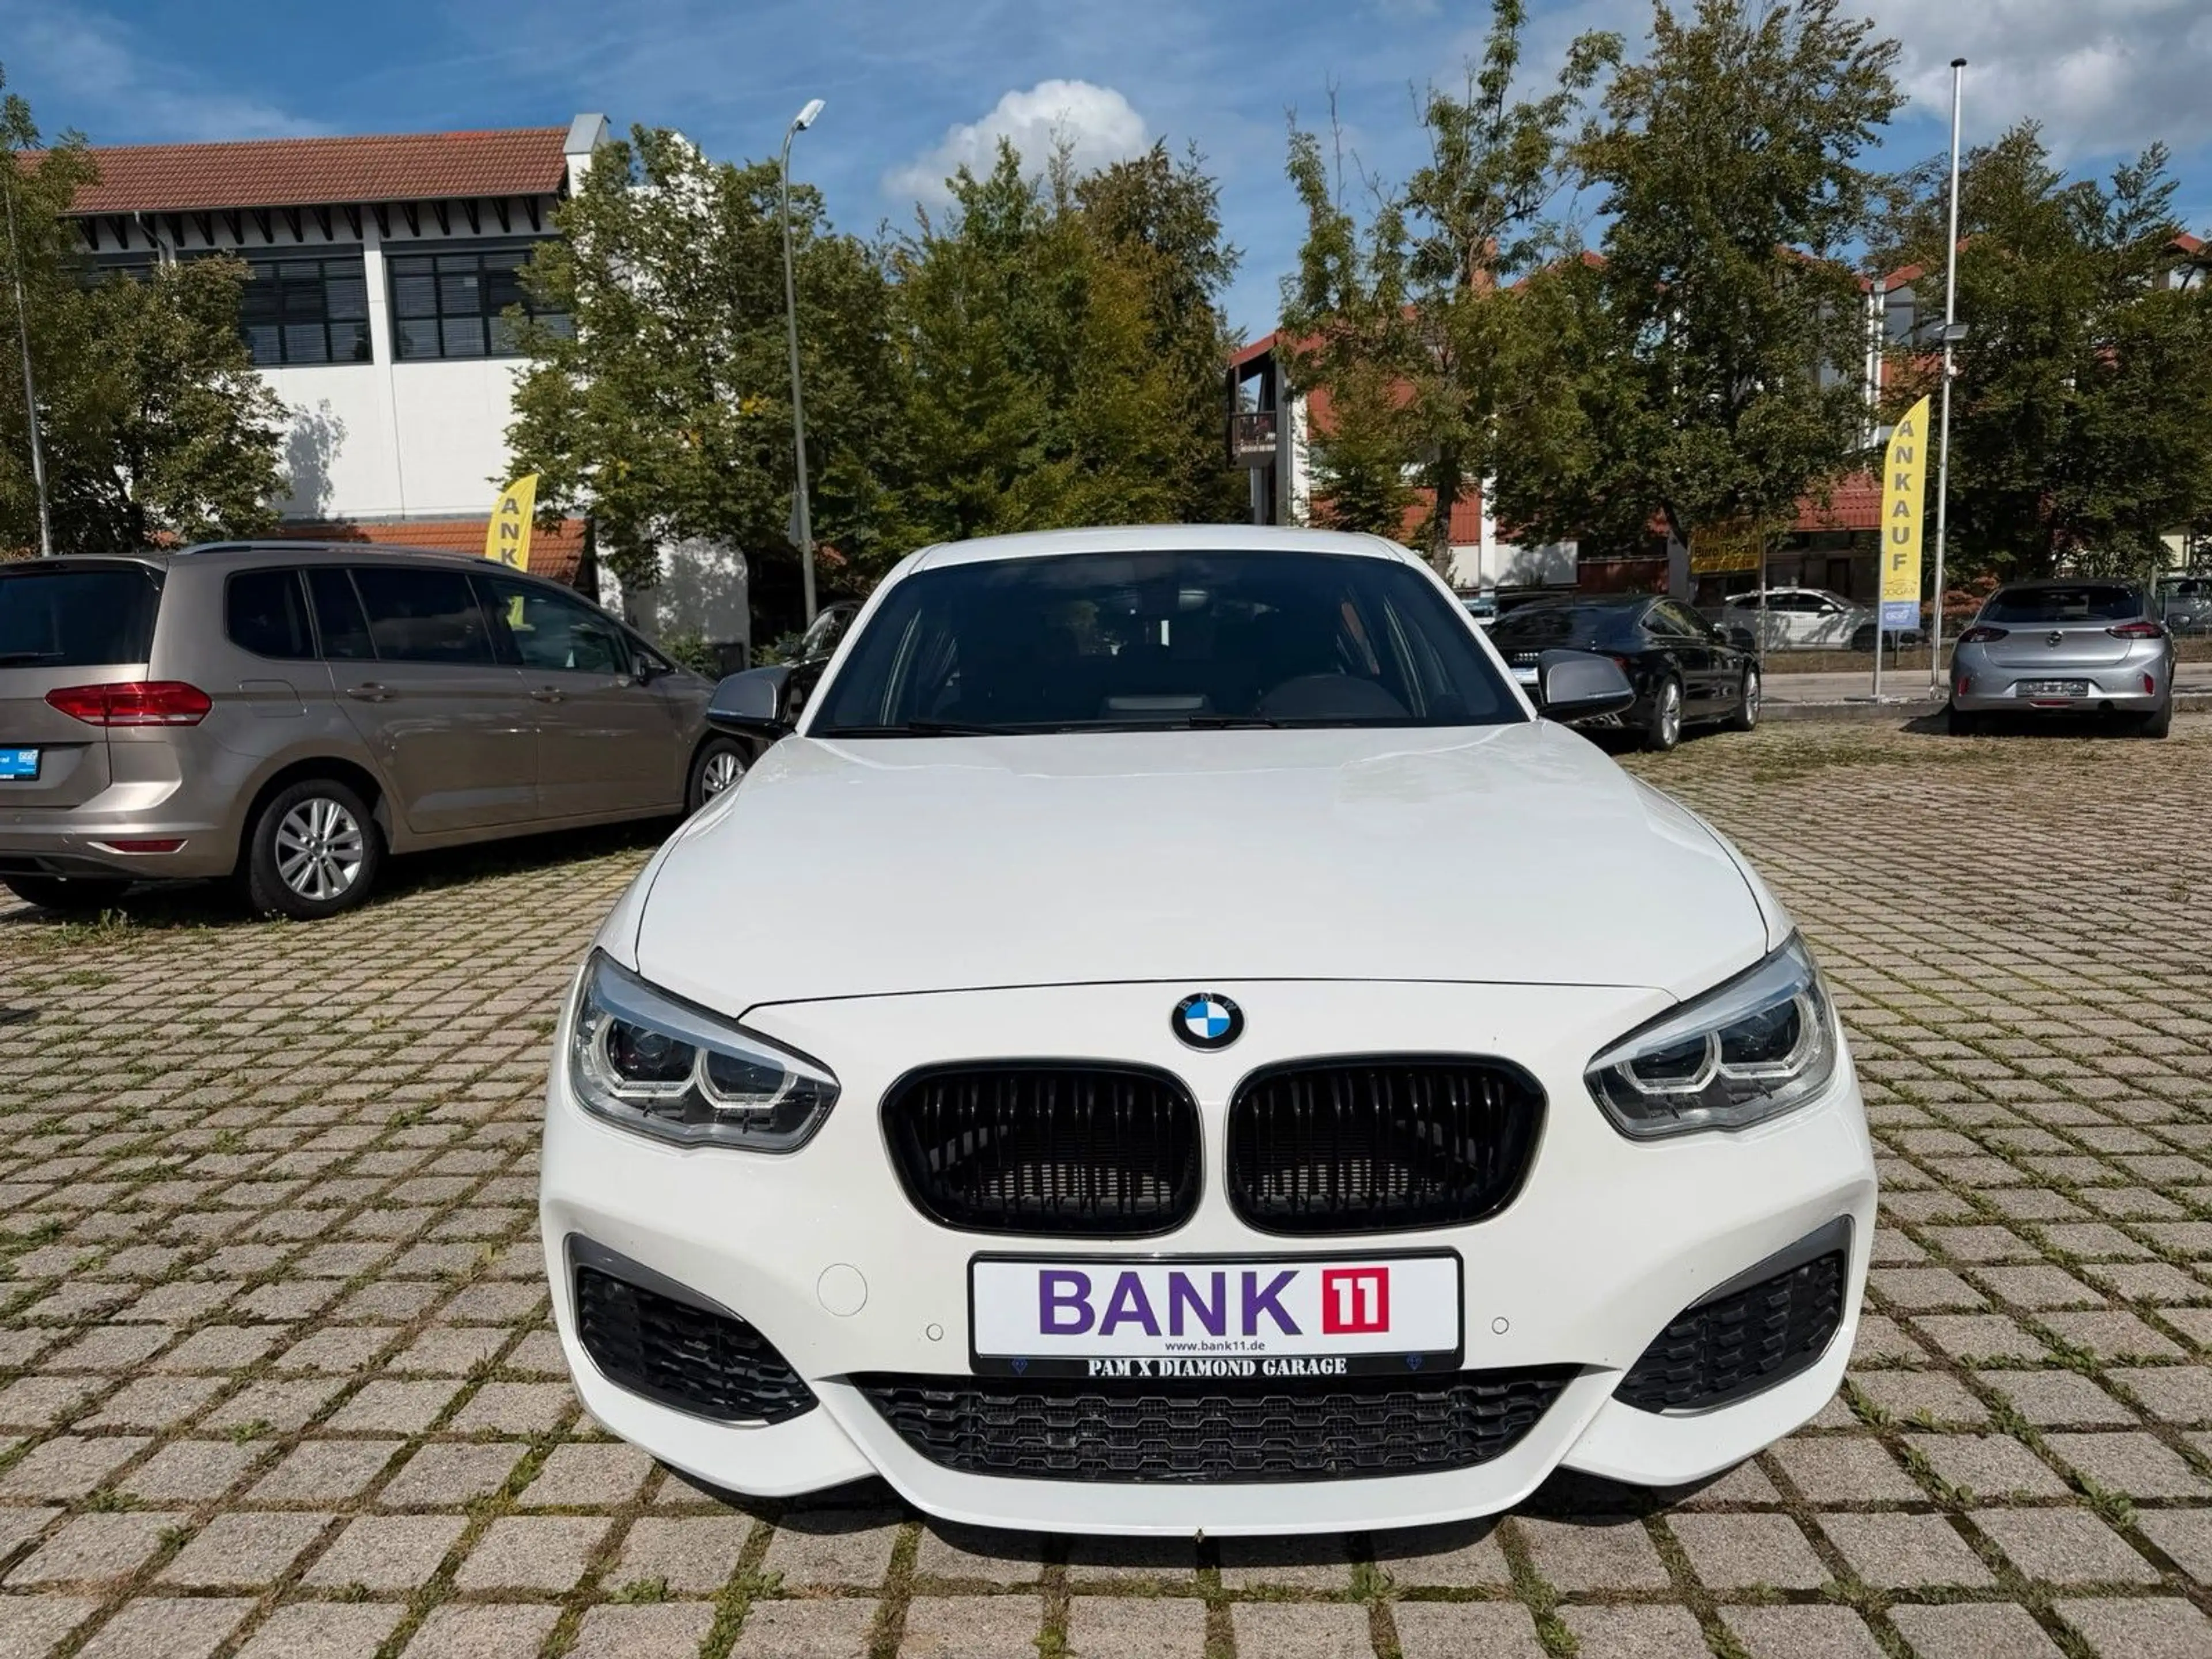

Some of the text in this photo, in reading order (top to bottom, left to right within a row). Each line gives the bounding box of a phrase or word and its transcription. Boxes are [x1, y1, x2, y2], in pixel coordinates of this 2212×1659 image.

[1892, 419, 1915, 571] ANKAUF
[1039, 1270, 1378, 1336] BANK 11
[1088, 1357, 1348, 1377] PAM X DIAMOND GARAGE
[1165, 1340, 1266, 1352] www.bank11.de
